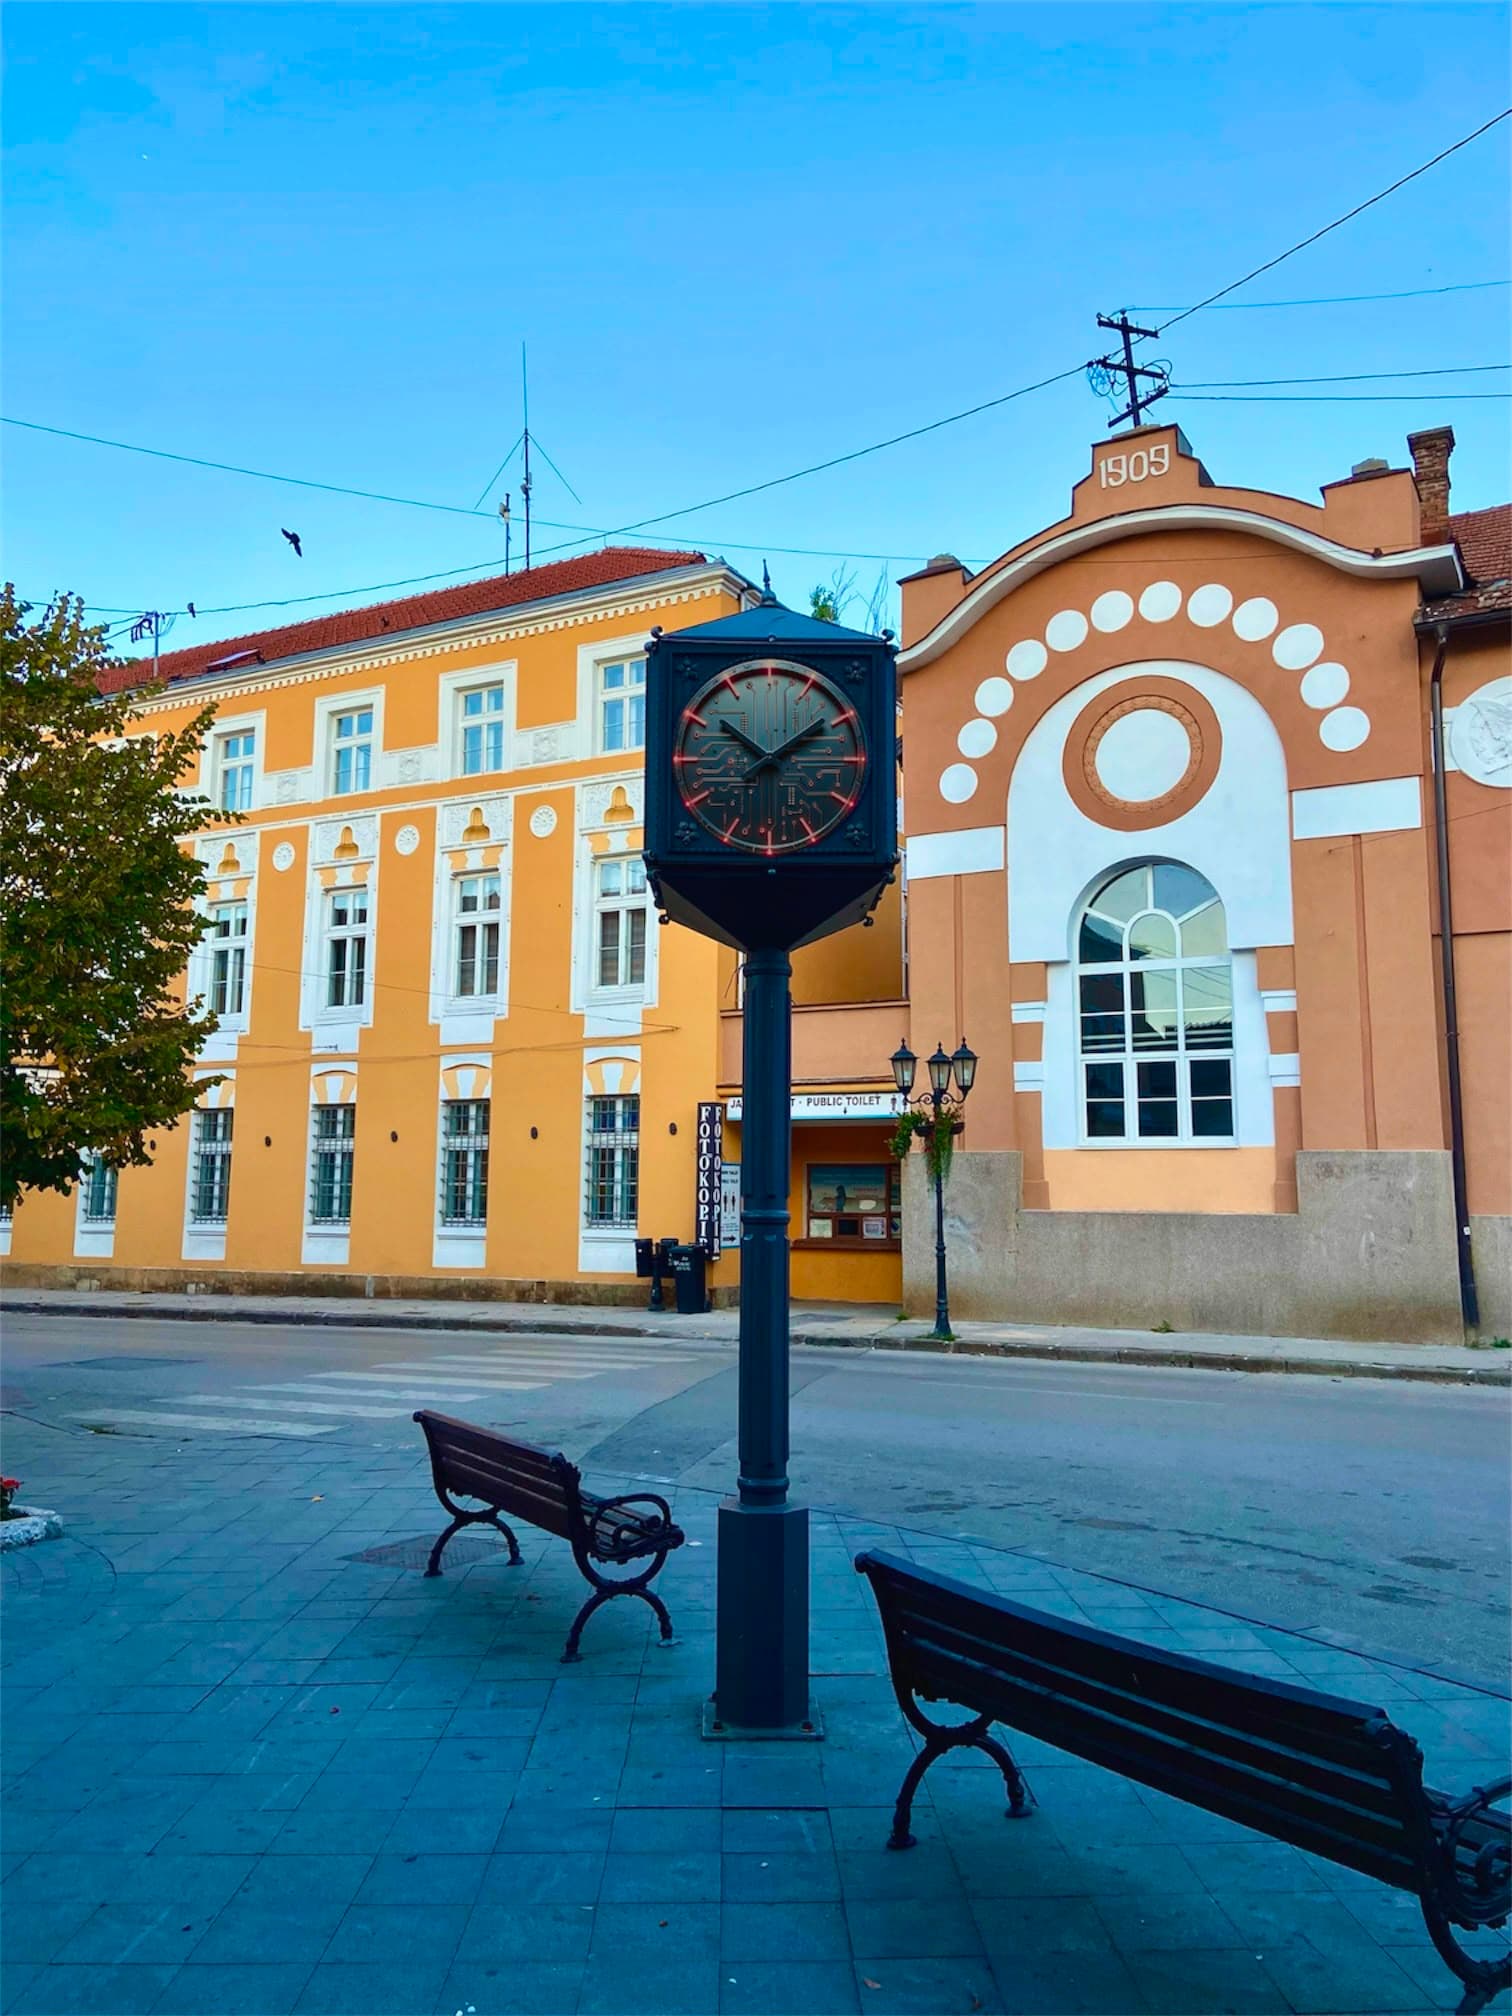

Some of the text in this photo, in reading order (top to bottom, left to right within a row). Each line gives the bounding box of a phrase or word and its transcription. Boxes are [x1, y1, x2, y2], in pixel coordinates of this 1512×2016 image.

[1099, 443, 1169, 489] 1909
[806, 1096, 843, 1107] PUBLIC
[845, 1095, 881, 1106] TOILET
[713, 1106, 722, 1254] FOTOKOPIR
